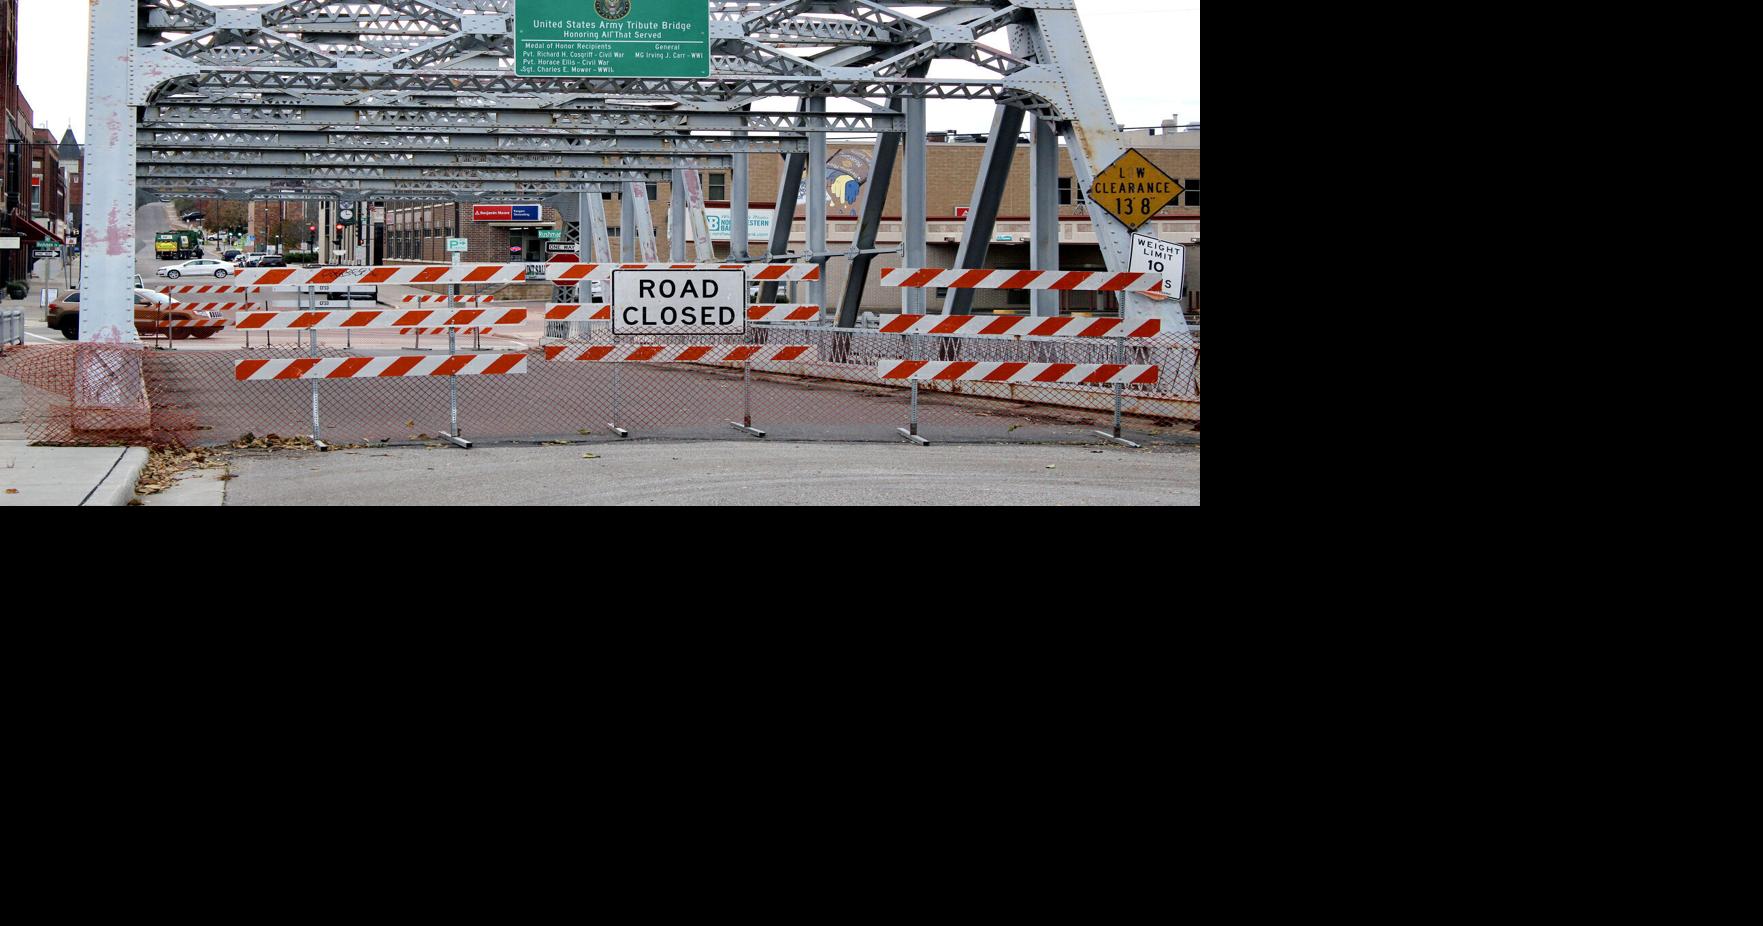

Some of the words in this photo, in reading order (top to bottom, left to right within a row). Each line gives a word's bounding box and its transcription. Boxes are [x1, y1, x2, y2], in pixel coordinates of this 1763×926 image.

[533, 20, 563, 28] United
[566, 20, 596, 29] States
[598, 21, 624, 30] Army
[626, 21, 659, 29] Tribute
[661, 21, 691, 30] Bridge
[563, 31, 599, 39] Honoring
[572, 51, 594, 59] Cosgriff
[646, 52, 664, 60] Irving
[1095, 182, 1170, 194] CLEARANCE
[1137, 238, 1180, 255] WEIGHT
[1143, 248, 1173, 261] LIMIT
[1148, 260, 1164, 272] 10
[639, 279, 719, 299] ROAD
[622, 306, 736, 328] CLOSED
